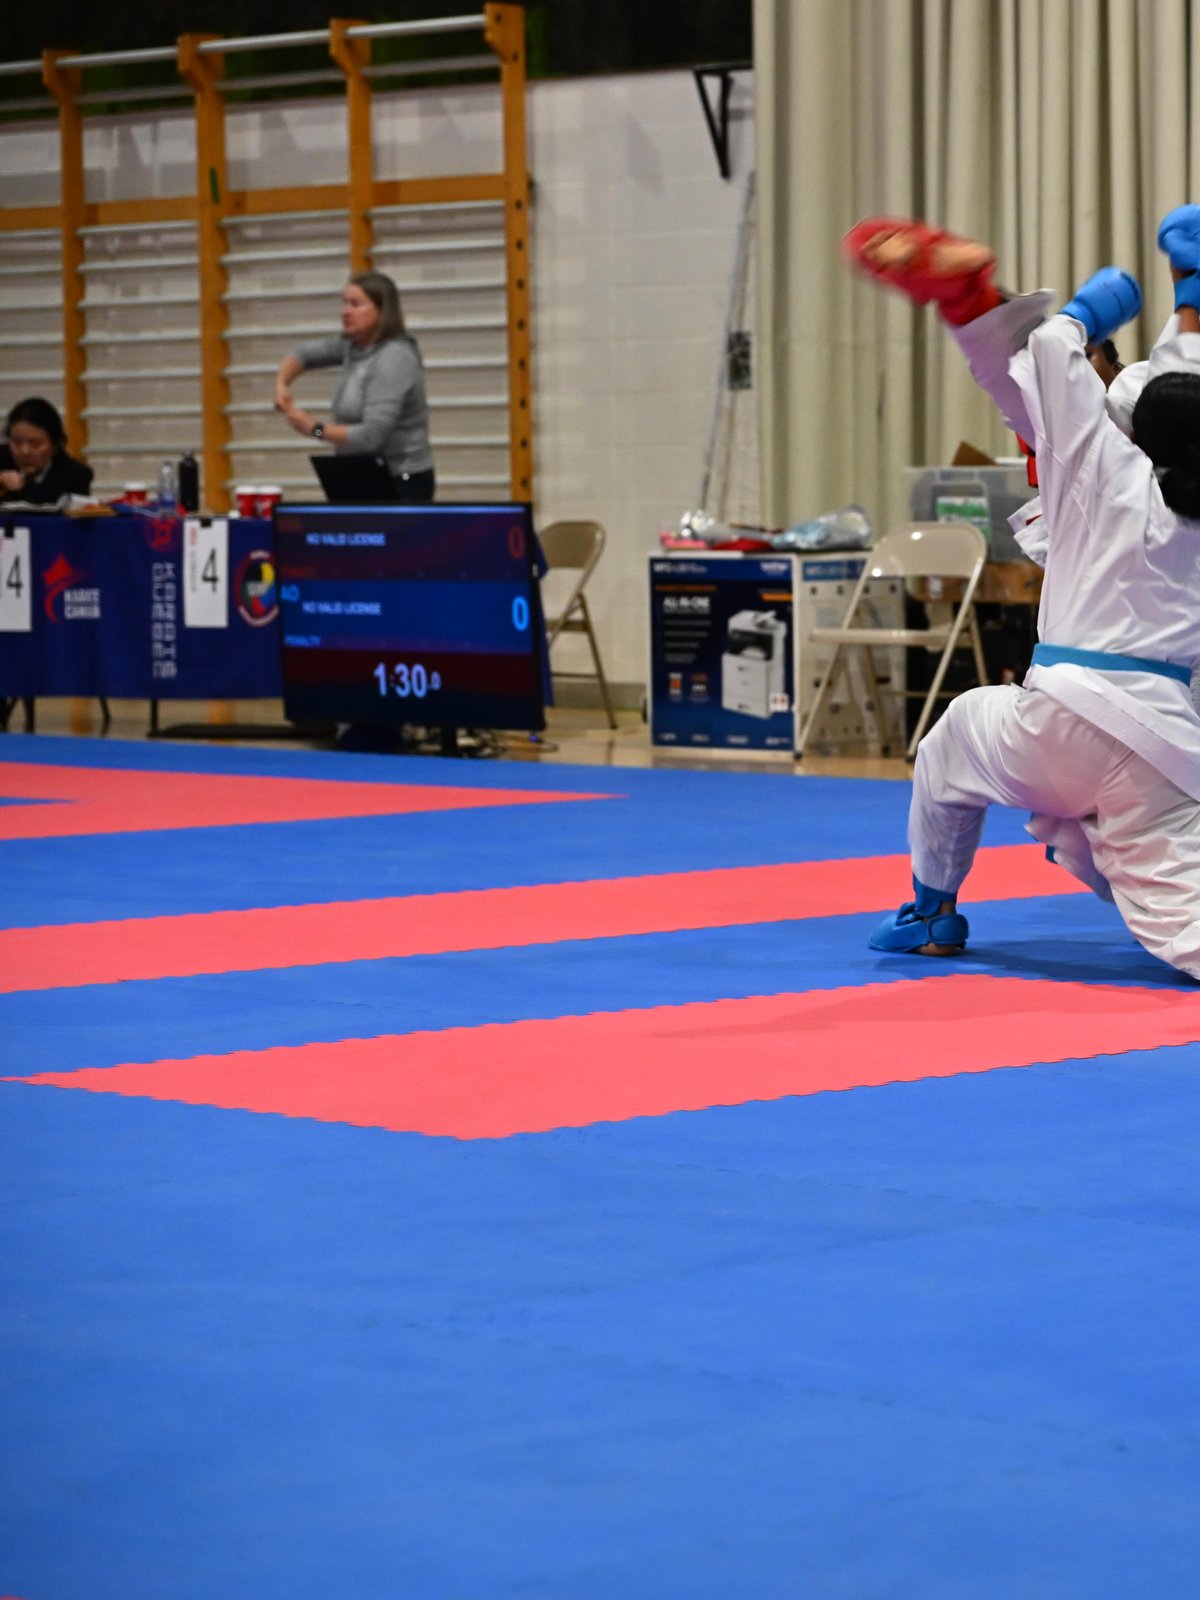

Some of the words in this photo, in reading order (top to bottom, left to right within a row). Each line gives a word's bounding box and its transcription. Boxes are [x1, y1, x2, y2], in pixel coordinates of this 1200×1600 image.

[508, 526, 525, 559] 0
[6, 554, 24, 598] 4
[201, 547, 219, 594] 4
[512, 596, 529, 632] 0
